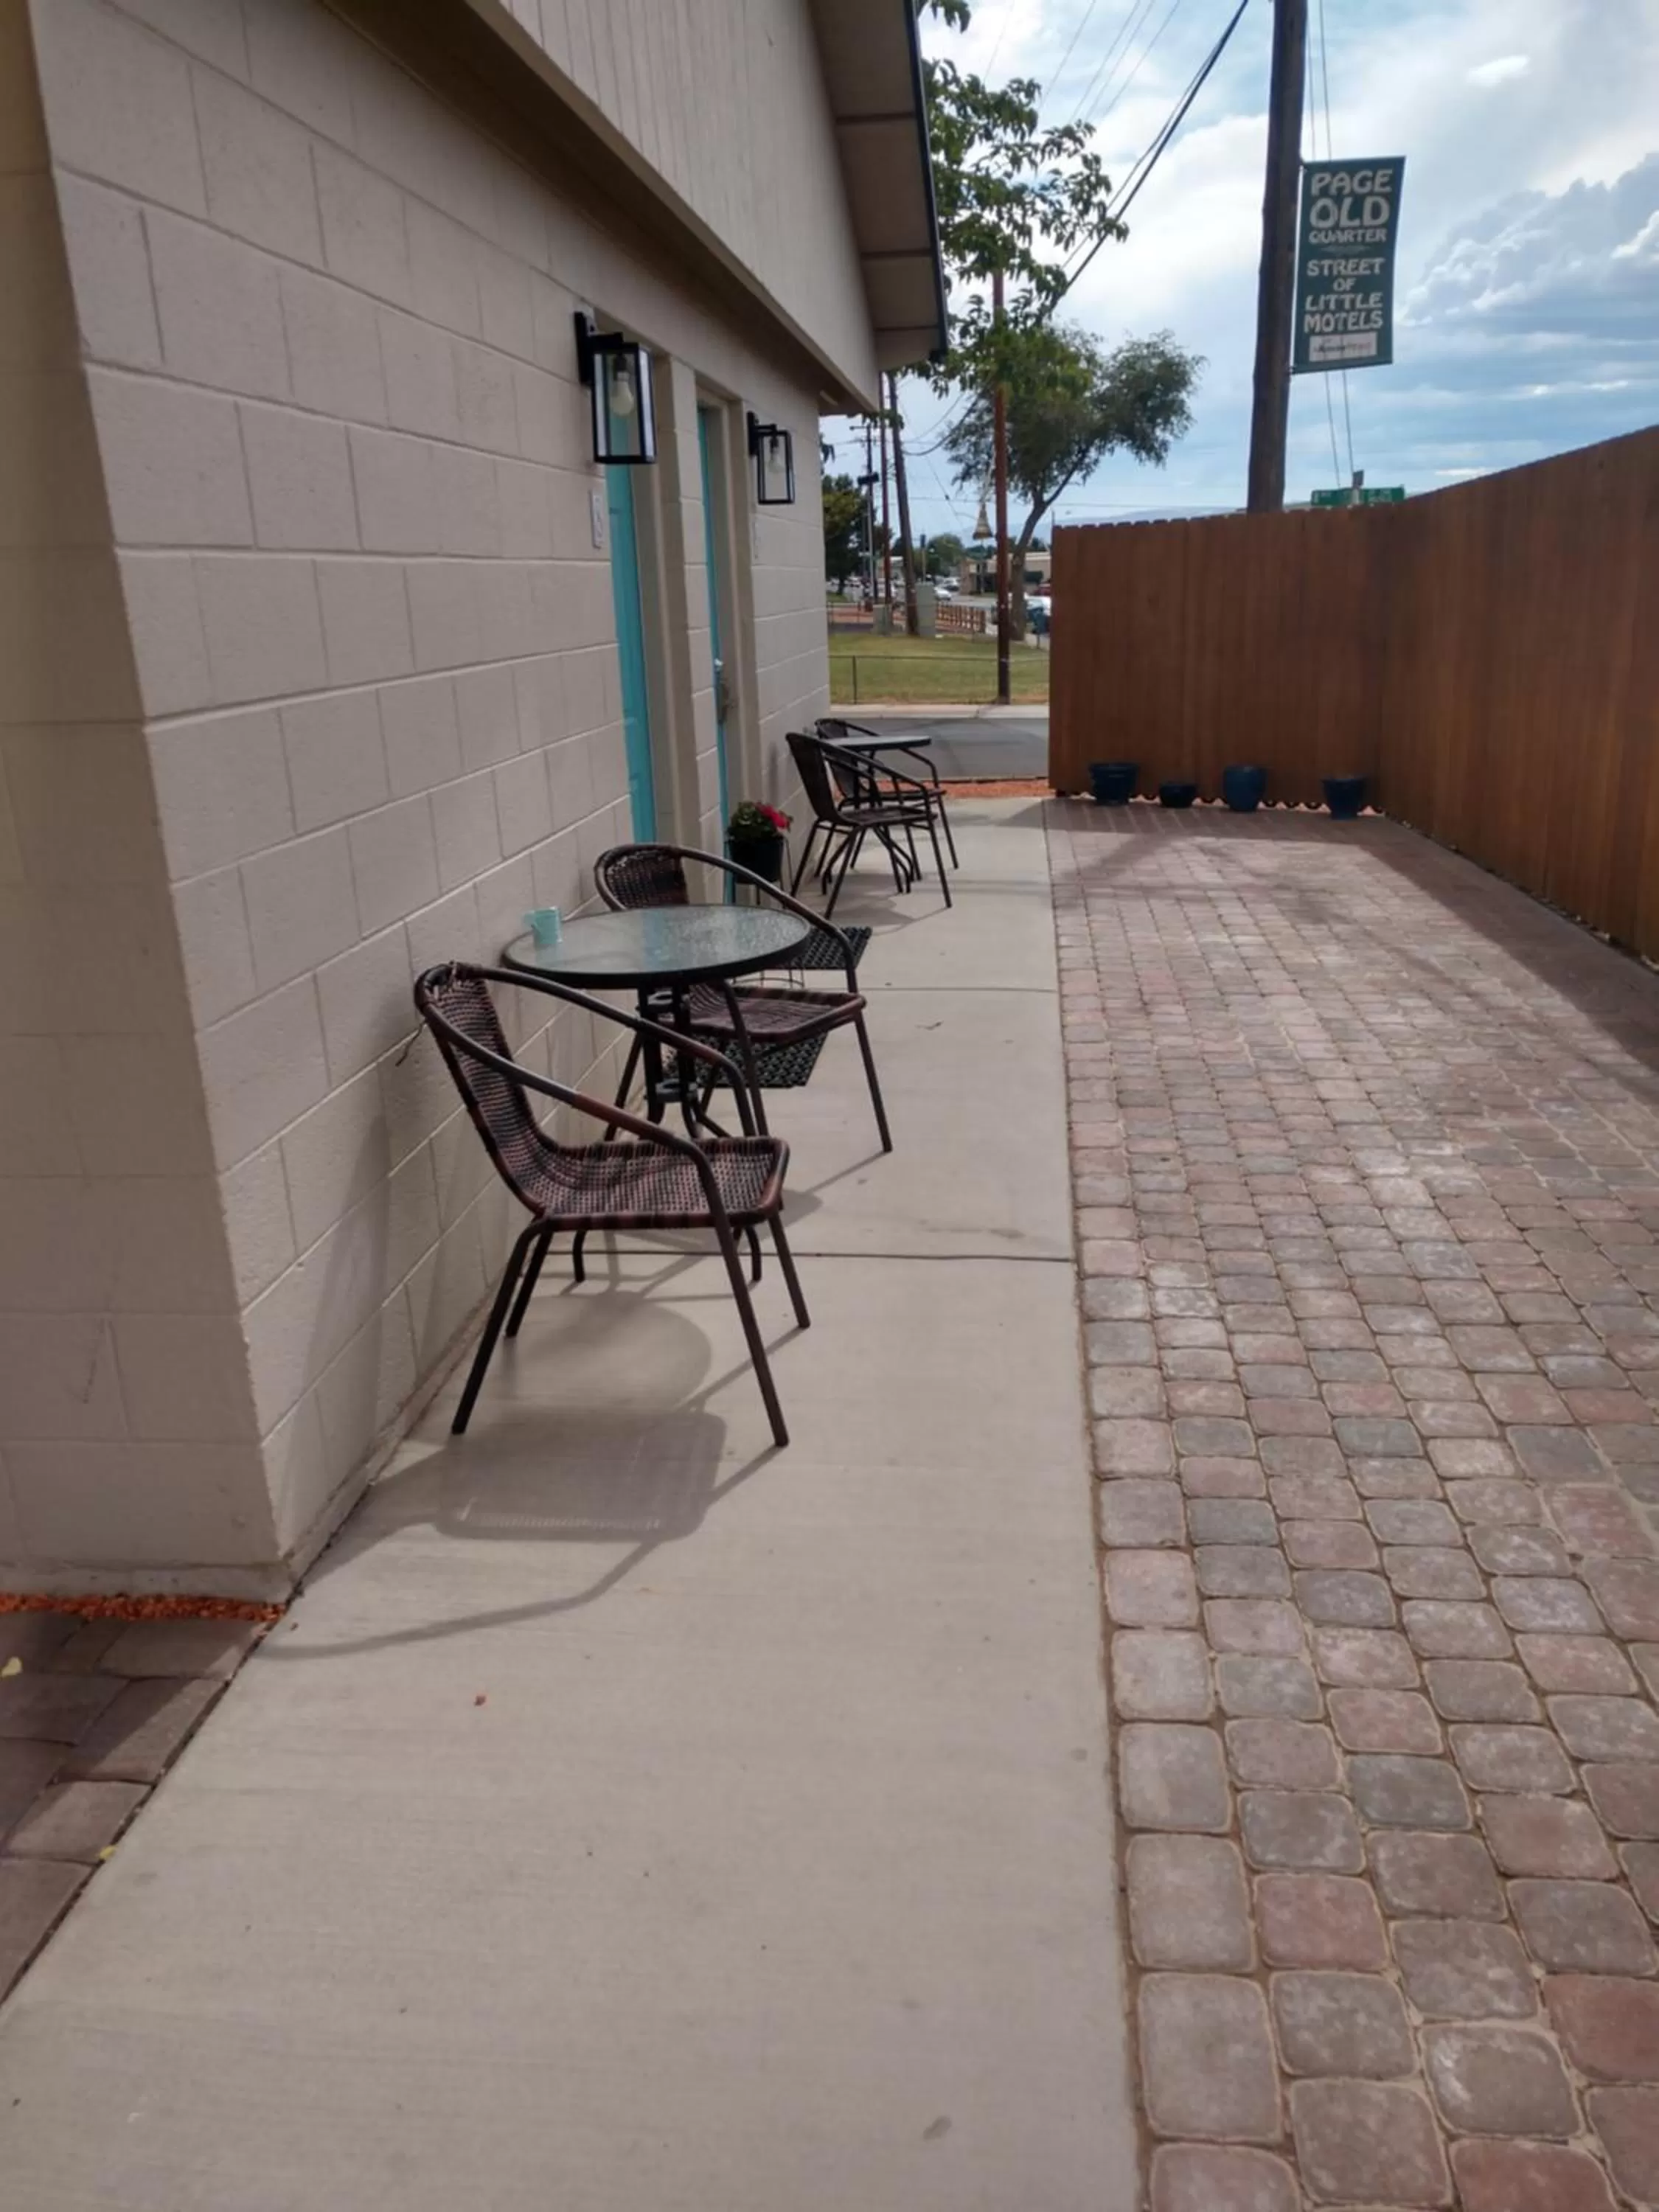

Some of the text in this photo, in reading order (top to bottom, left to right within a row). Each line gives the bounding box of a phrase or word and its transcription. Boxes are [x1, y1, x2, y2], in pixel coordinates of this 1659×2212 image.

[1311, 169, 1393, 196] PAGE
[1310, 195, 1390, 229] OLD
[1308, 228, 1387, 244] QUARTER
[1307, 258, 1385, 276] STREET
[1333, 277, 1357, 292] OF
[1305, 292, 1382, 311] LITTLE
[1304, 310, 1383, 333] MOTELS
